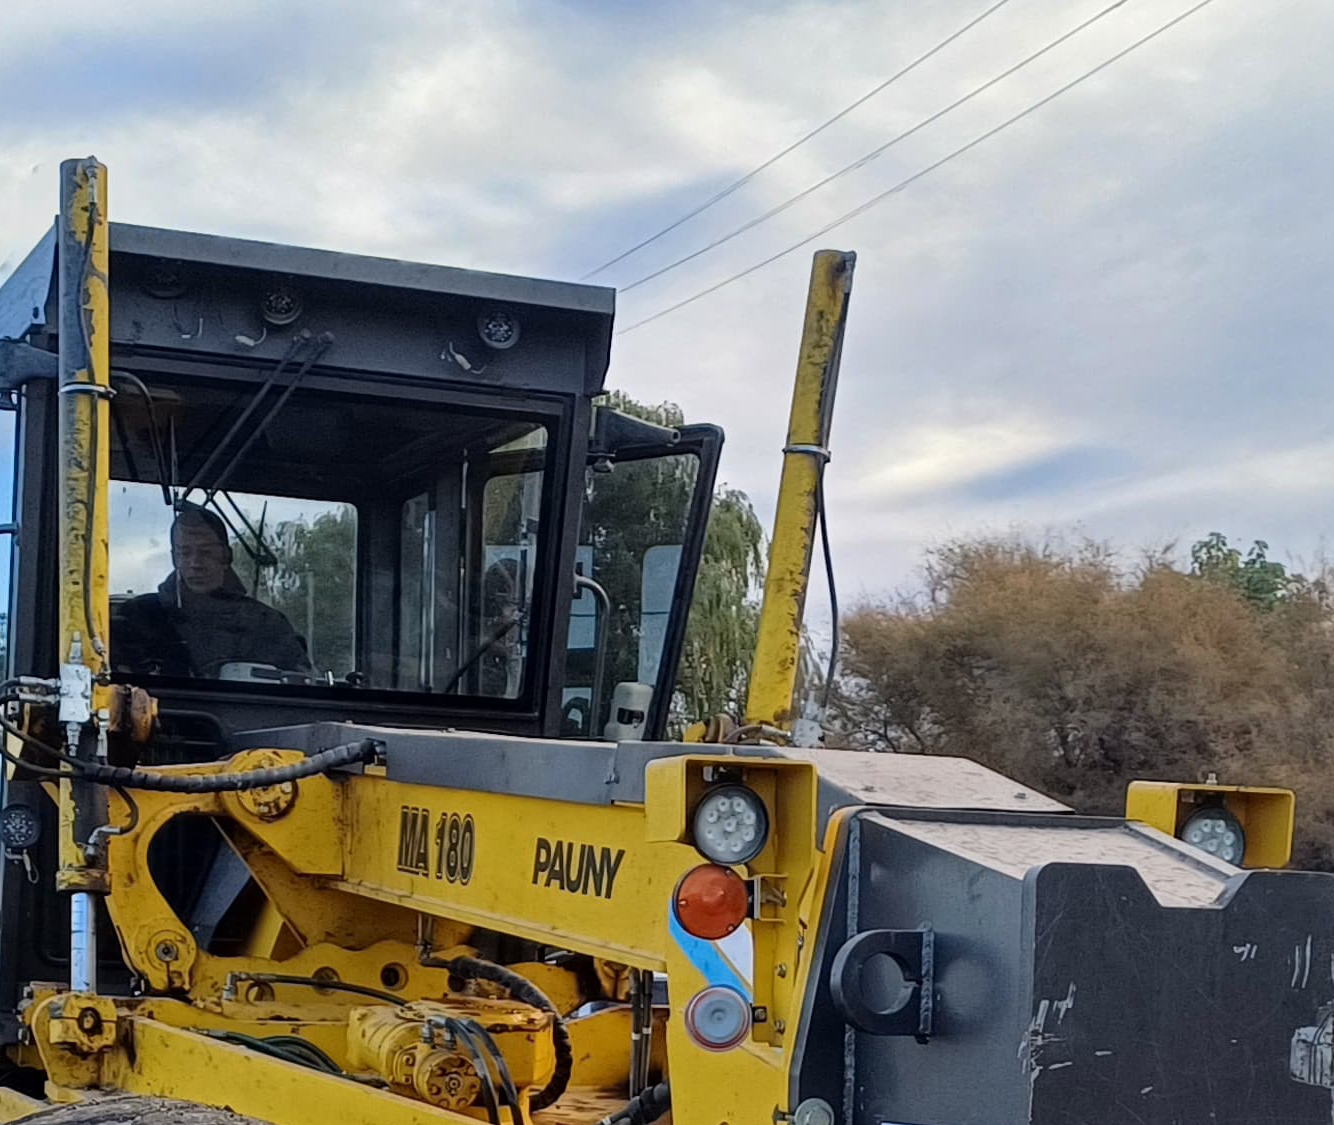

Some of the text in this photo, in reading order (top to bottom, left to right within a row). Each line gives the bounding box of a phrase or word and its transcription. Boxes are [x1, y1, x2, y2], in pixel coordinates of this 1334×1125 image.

[396, 805, 475, 886] MA 180
[531, 837, 626, 900] PAUNY
